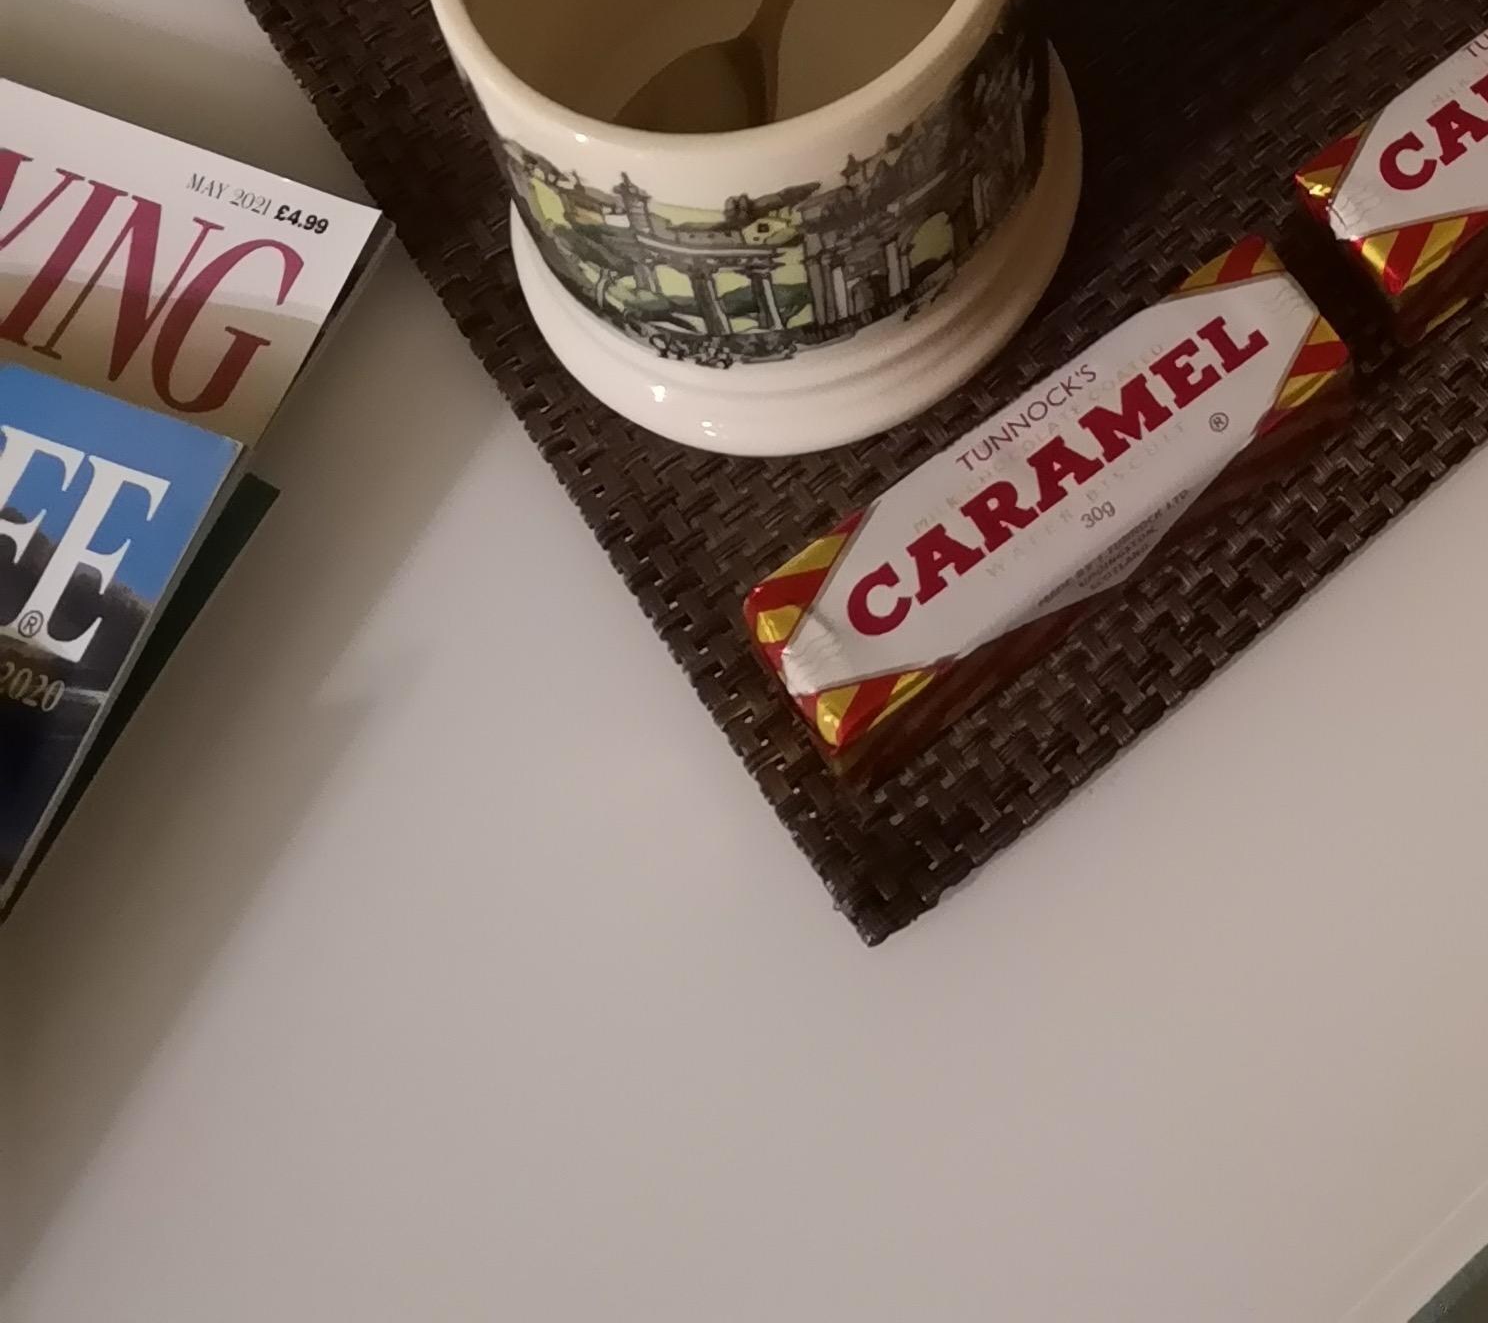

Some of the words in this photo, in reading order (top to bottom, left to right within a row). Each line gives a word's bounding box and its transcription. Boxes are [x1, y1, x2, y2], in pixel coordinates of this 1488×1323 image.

[186, 173, 229, 200] MAY
[230, 188, 272, 216] 2021
[274, 205, 329, 235] £4.99
[956, 363, 1097, 472] TUNNOCK'S
[846, 316, 1268, 636] CARAMEL
[1080, 499, 1117, 531] 30g
